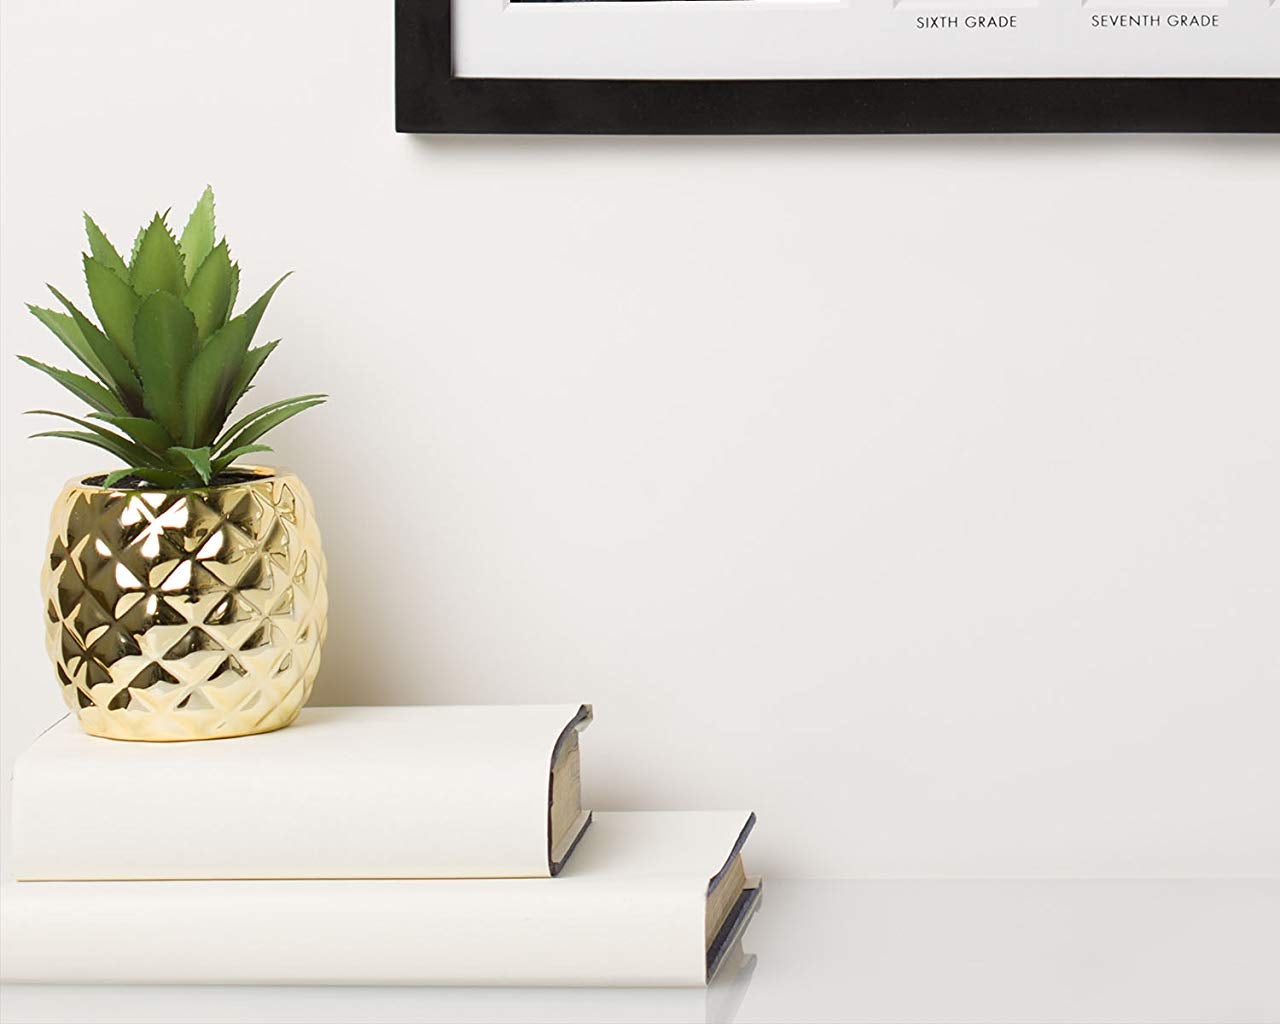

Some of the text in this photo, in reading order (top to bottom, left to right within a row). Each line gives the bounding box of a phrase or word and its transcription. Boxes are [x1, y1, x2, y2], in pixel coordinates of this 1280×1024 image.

[916, 15, 1017, 29] SIXTH GRADE
[1091, 14, 1218, 28] SEVENTH GRADE
